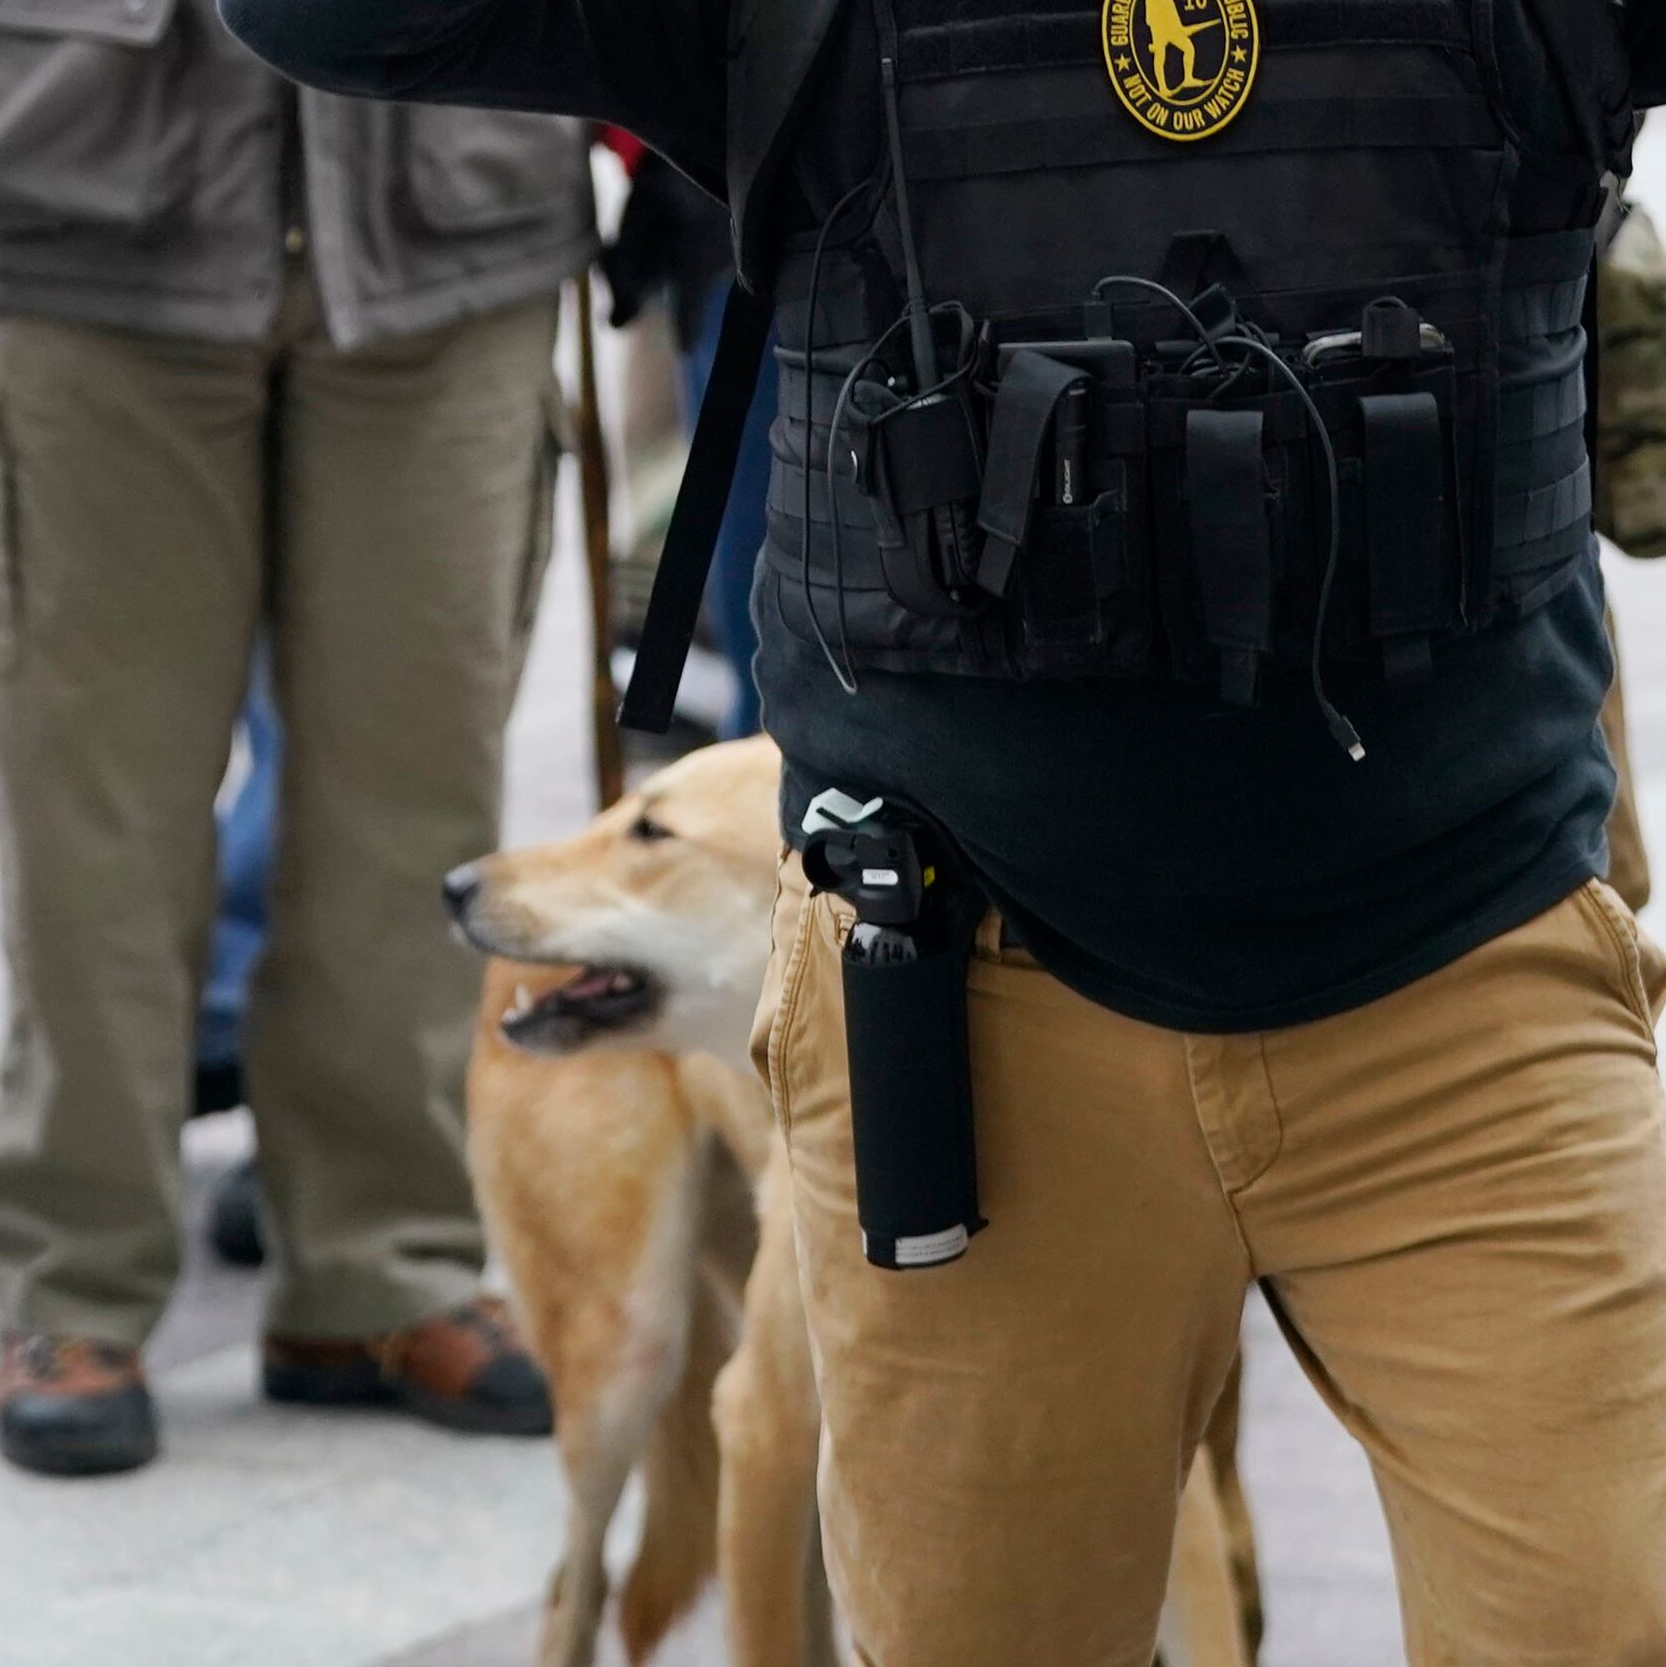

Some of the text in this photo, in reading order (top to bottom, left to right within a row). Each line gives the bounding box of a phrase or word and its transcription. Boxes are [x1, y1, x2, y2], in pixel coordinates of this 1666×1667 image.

[1123, 67, 1245, 131] NOT ON OUR WATCH
